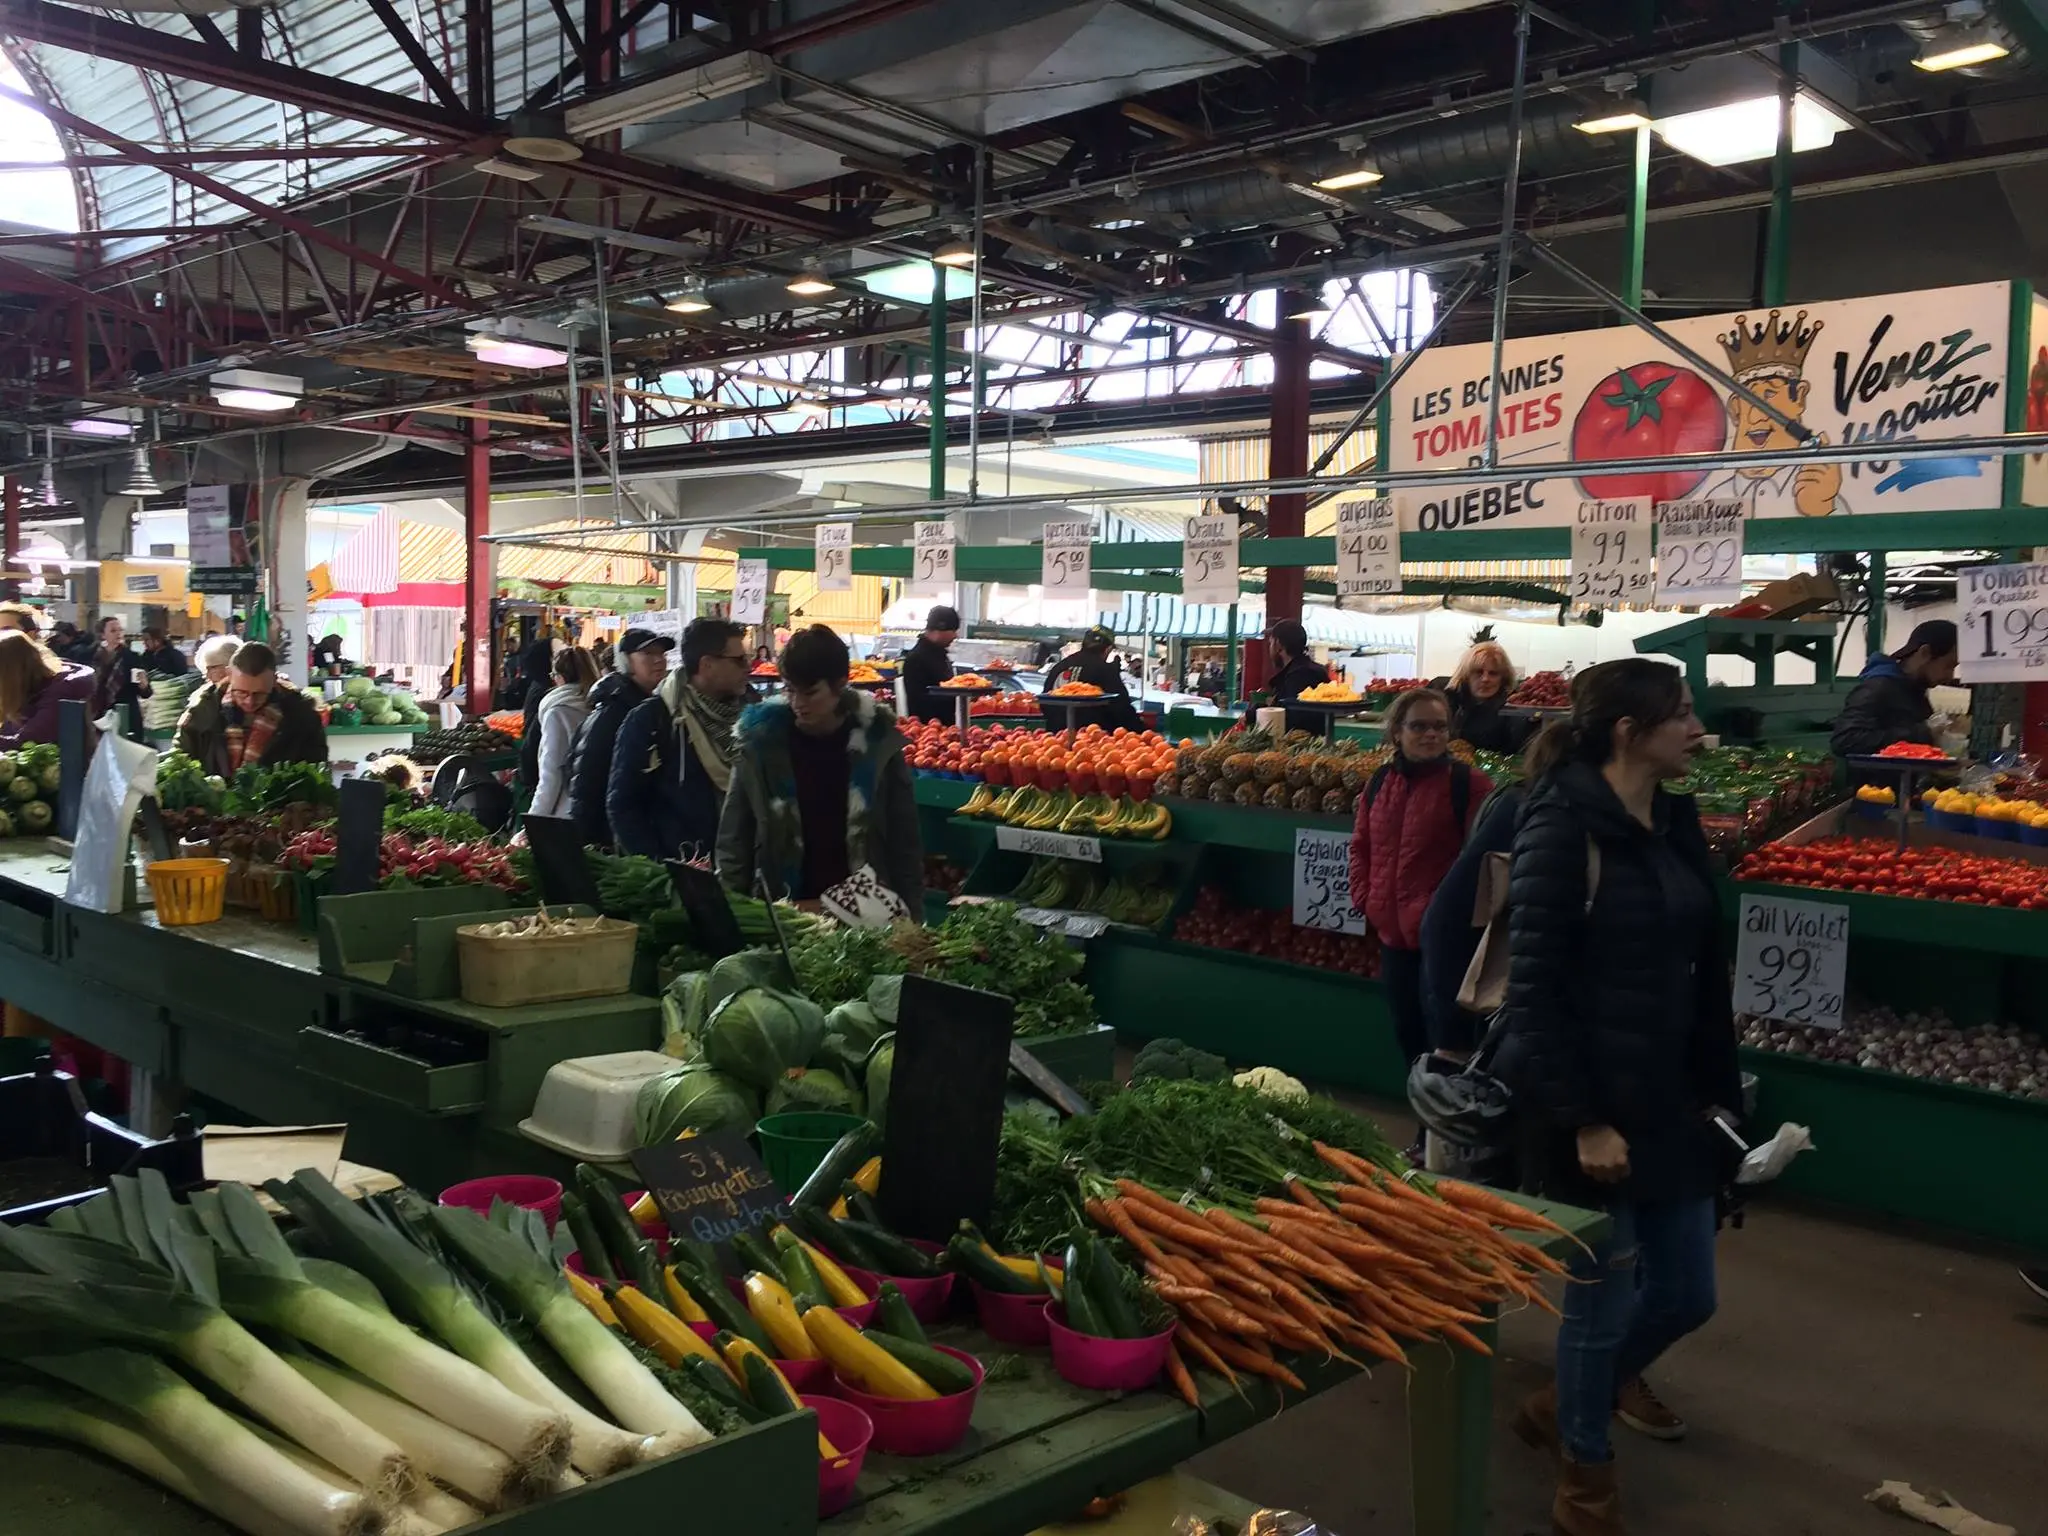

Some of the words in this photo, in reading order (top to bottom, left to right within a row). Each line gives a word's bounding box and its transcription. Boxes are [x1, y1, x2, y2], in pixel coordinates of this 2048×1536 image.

[1834, 313, 1992, 416] Venez
[1412, 386, 1452, 422] LES
[1462, 354, 1564, 409] BONNES
[1412, 392, 1562, 462] TOMATES
[1418, 478, 1546, 532] QUÉBEC
[1576, 572, 1591, 598] 3
[1783, 910, 1848, 942] Violet
[1750, 981, 1777, 1015] 3
[679, 1152, 707, 1178] 3
